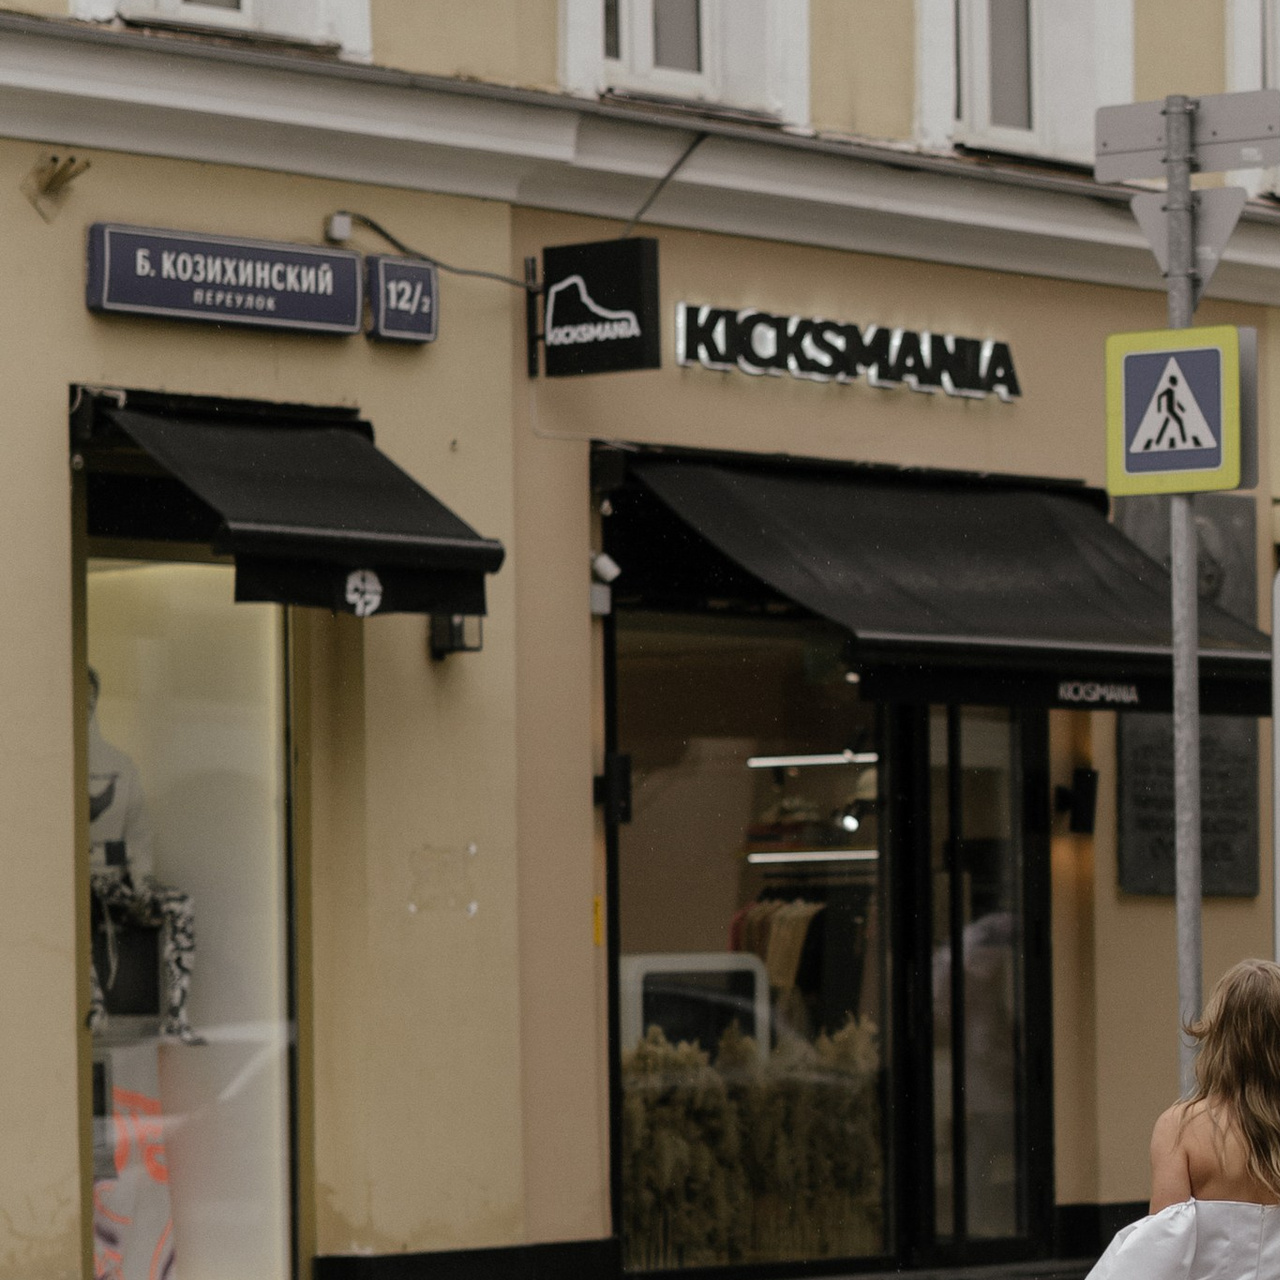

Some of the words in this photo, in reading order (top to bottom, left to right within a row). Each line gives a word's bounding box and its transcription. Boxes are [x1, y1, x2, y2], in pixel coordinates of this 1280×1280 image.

[135, 248, 157, 279] Б.
[162, 250, 334, 296] КОЗИХИНСКИЙ
[193, 289, 277, 312] ПЕРЕУЛОК
[546, 317, 641, 346] KICKSMANIA
[678, 302, 1022, 402] KICKSMANIA
